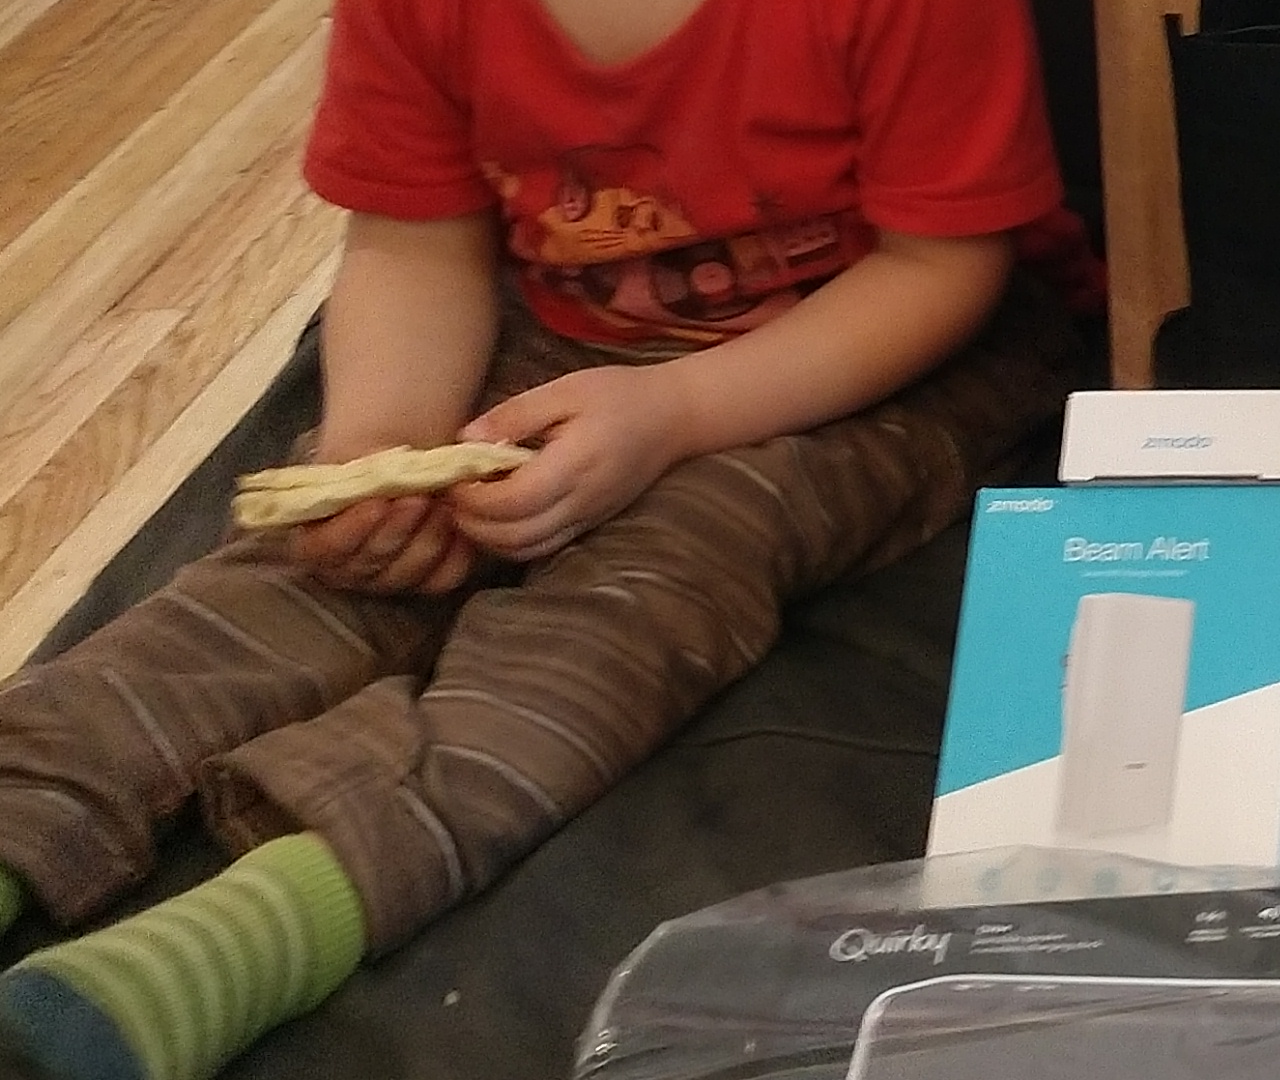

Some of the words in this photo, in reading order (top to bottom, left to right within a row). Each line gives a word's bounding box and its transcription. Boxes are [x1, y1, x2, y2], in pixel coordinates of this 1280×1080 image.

[1141, 434, 1213, 450] zmodo
[986, 497, 1054, 513] zmodo
[1063, 537, 1143, 562] Beam
[1146, 536, 1210, 561] Alert
[829, 924, 952, 966] Quirky
